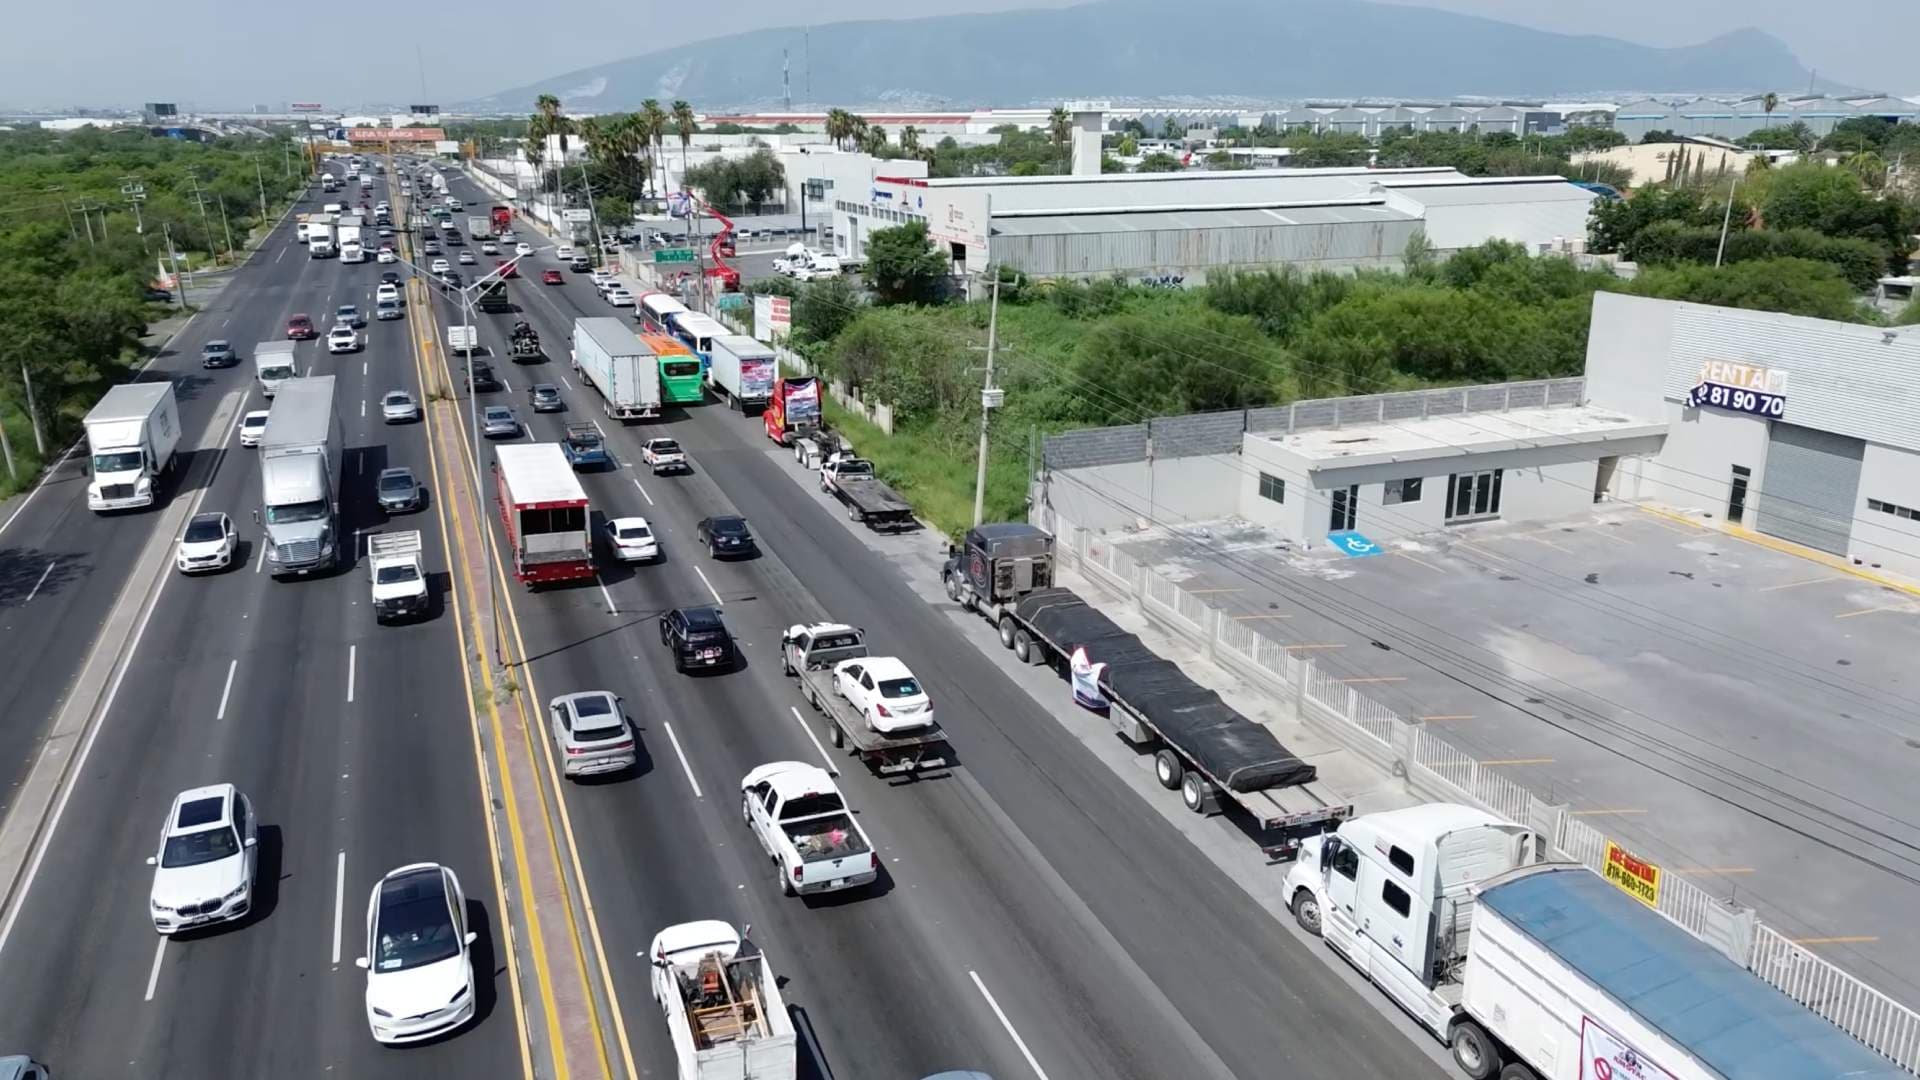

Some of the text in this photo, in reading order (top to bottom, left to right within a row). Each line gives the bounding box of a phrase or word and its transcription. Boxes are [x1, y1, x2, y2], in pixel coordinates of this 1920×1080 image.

[1710, 386, 1730, 406] 81
[1733, 391, 1755, 411] 90
[1760, 395, 1784, 415] 70
